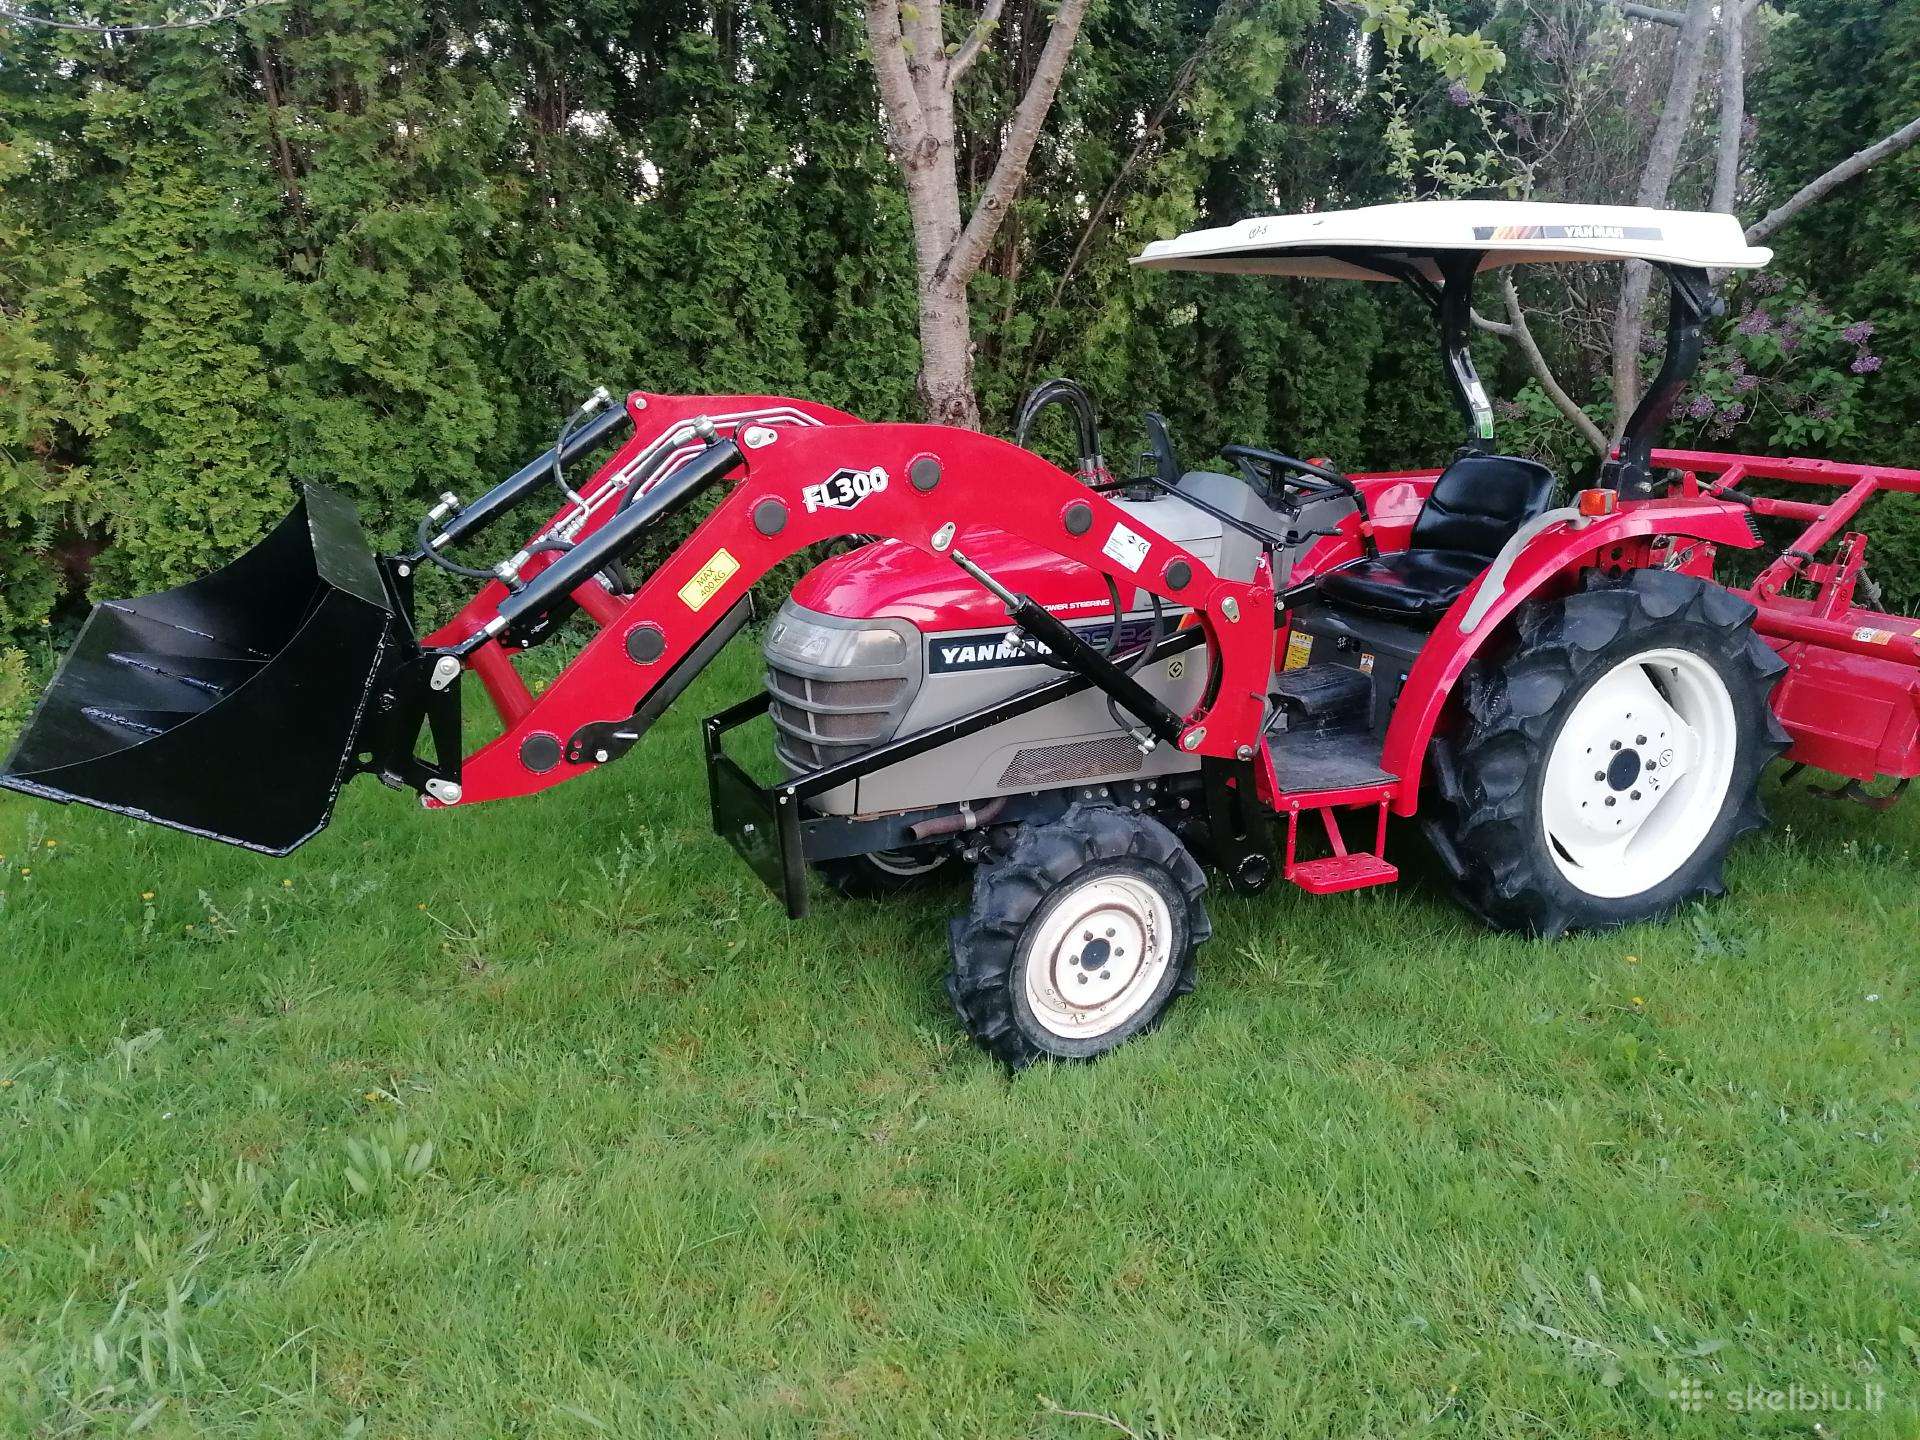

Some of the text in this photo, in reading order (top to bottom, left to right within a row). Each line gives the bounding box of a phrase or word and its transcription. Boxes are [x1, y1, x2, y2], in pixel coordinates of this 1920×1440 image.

[1565, 225, 1624, 239] YANMAR
[802, 466, 888, 514] FL300
[697, 568, 715, 586] MAX
[701, 570, 726, 596] 400 KG
[1043, 599, 1110, 612] OWER STEERING
